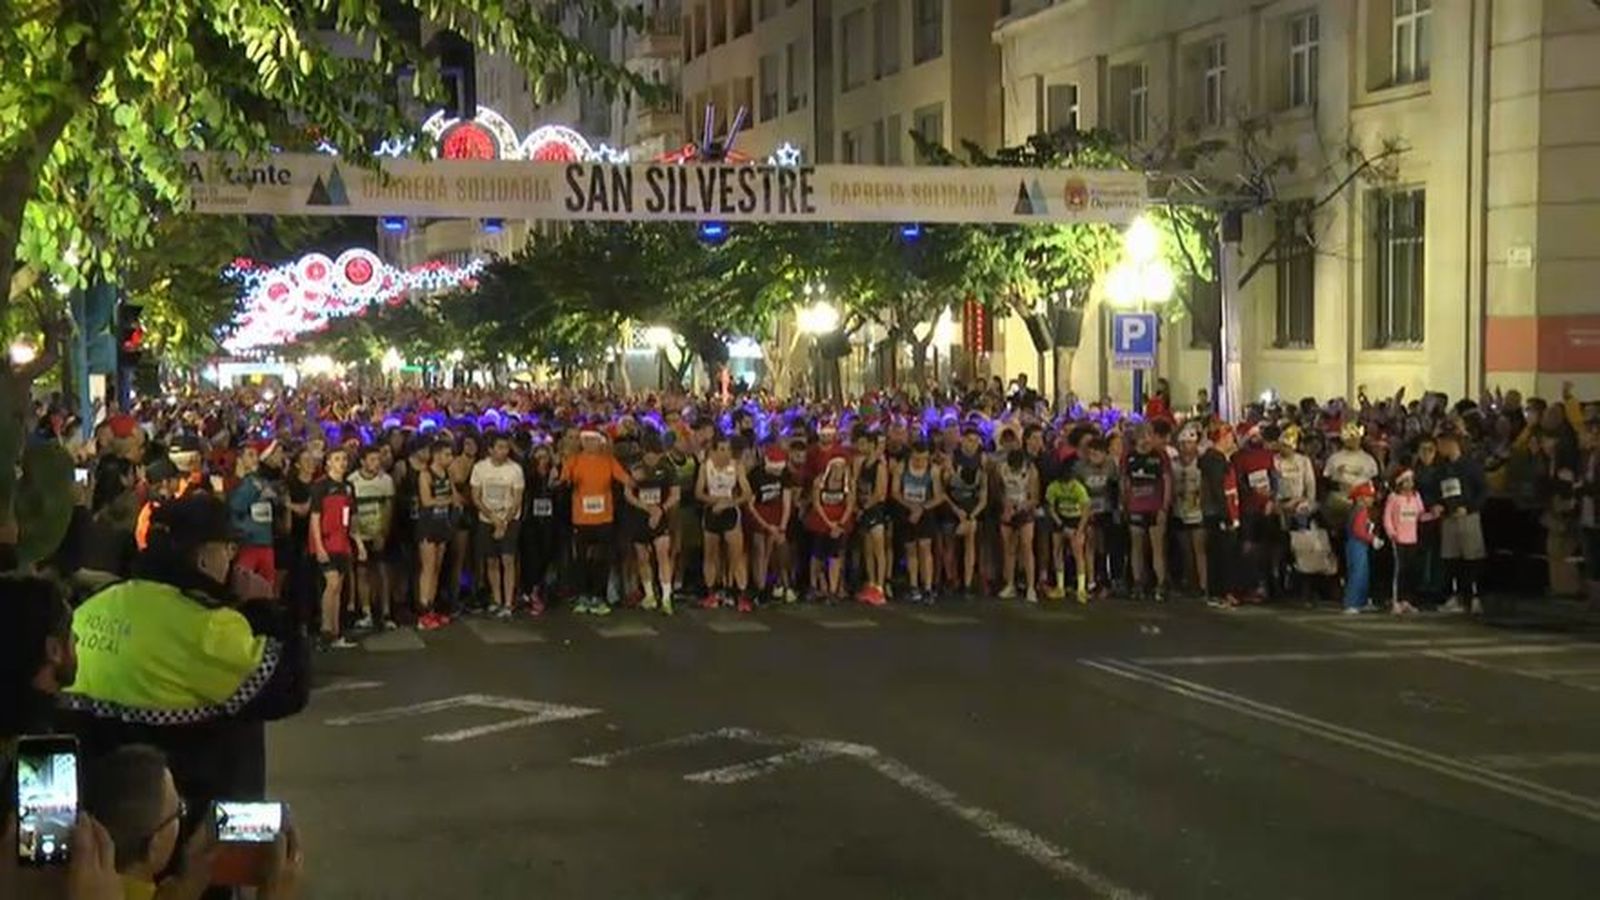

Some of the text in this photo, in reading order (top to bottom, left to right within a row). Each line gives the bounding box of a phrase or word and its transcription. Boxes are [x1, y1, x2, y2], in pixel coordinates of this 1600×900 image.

[455, 176, 551, 202] SOLIDARIA
[564, 163, 815, 214] SAN SILVESTRE
[830, 181, 998, 208] CARRERA SOLIDARIA
[1122, 318, 1147, 350] P
[81, 633, 120, 656] LOCAL
